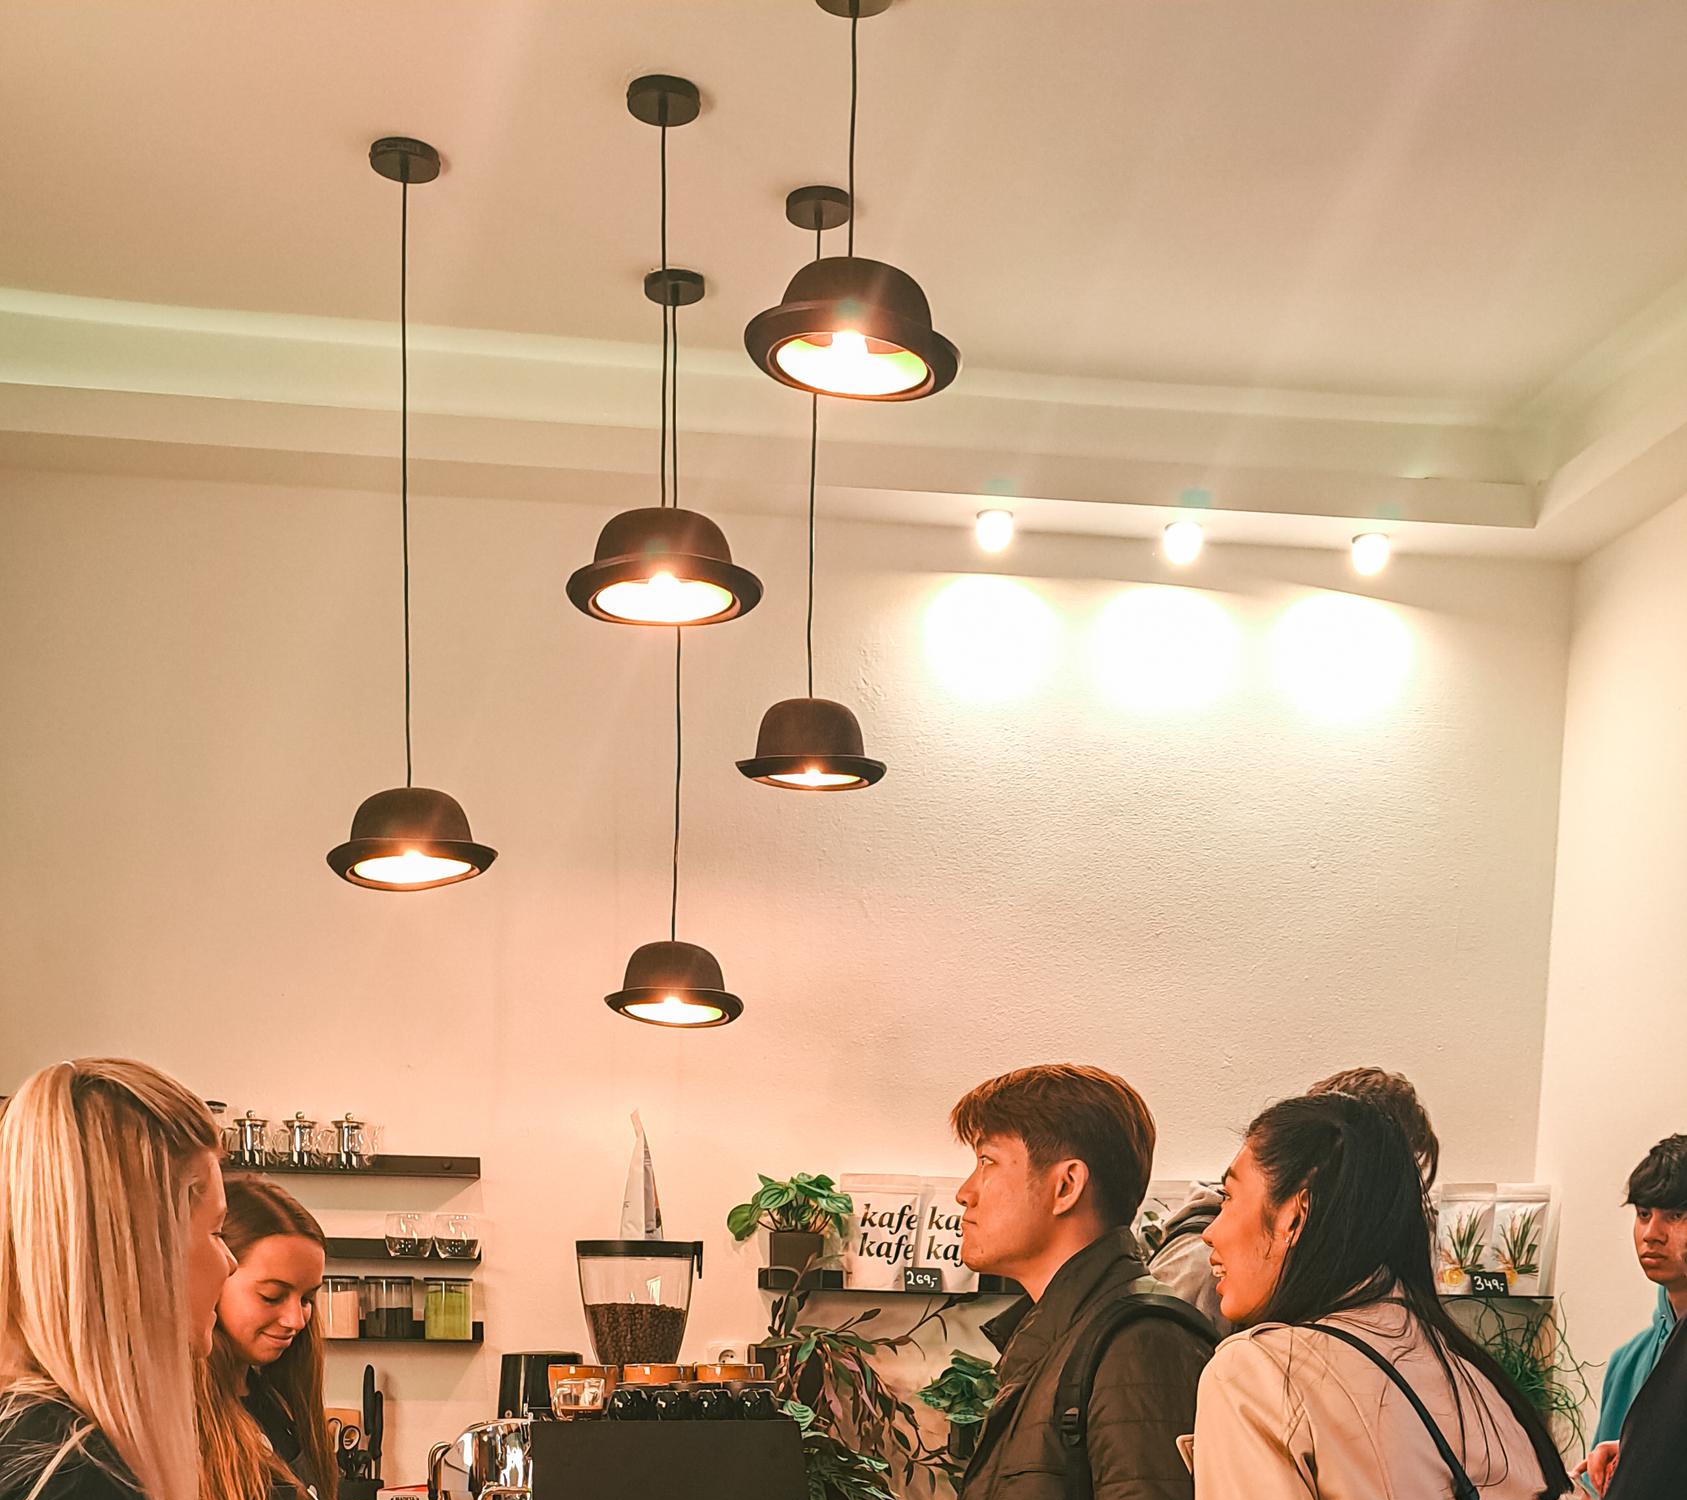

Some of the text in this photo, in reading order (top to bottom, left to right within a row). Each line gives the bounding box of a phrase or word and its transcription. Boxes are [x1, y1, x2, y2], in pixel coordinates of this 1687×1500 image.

[860, 1203, 918, 1235] kafe
[858, 1233, 914, 1265] kafe
[906, 1270, 938, 1288] 269,-
[1473, 1275, 1505, 1293] 349,-
